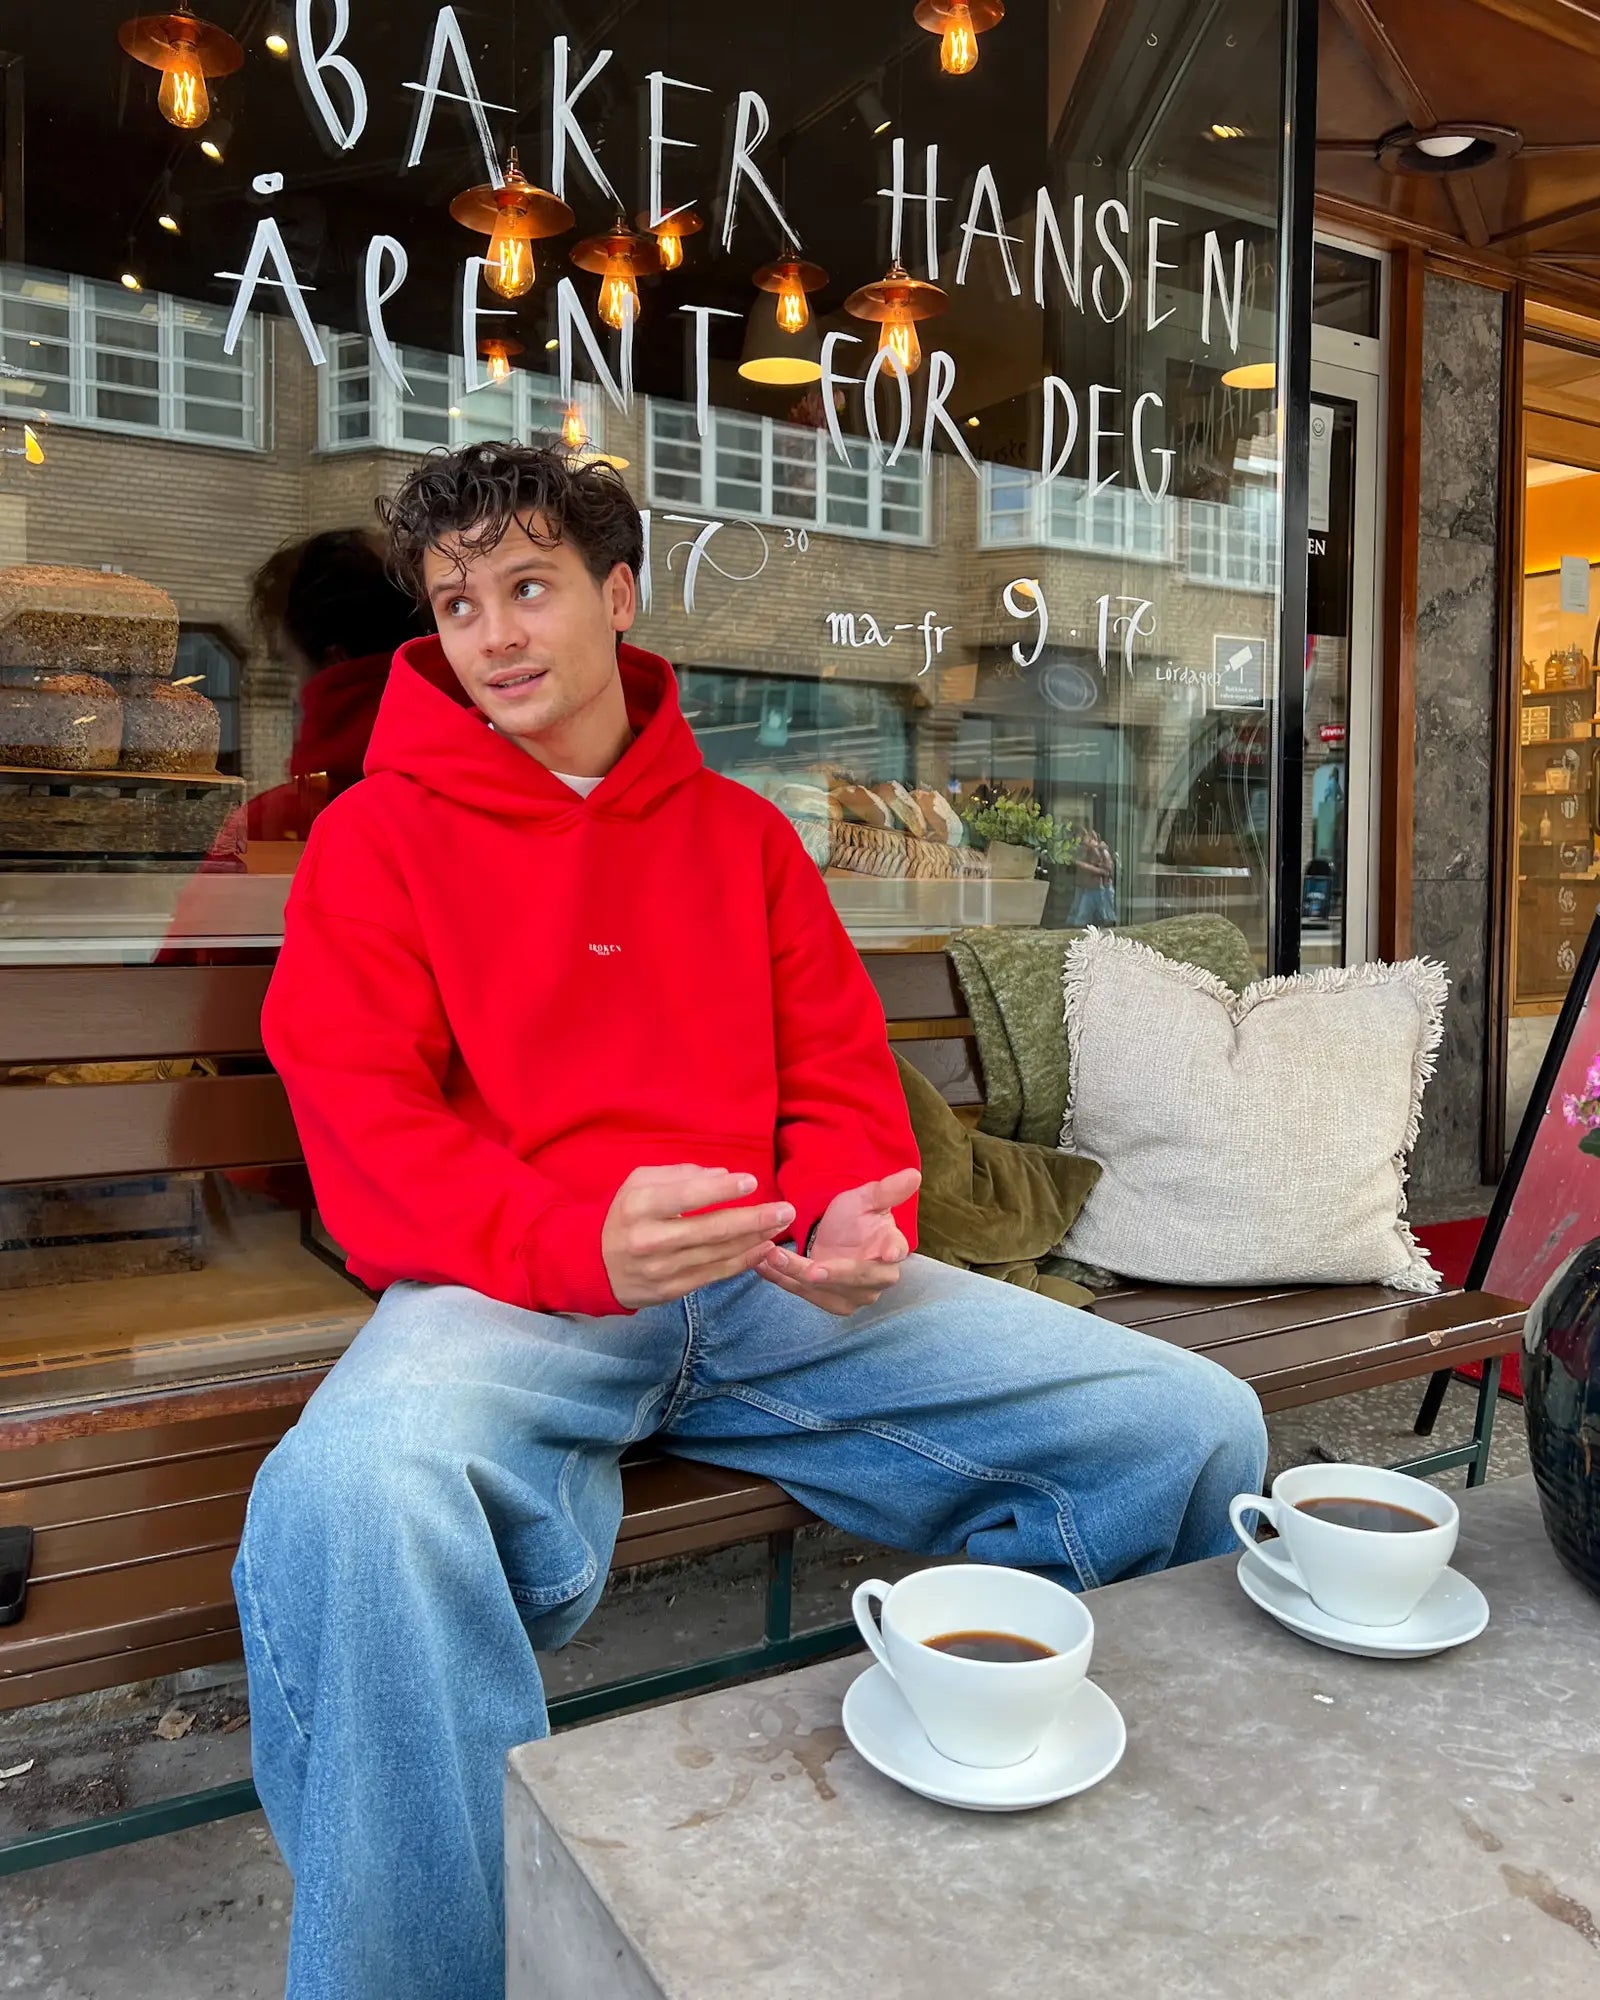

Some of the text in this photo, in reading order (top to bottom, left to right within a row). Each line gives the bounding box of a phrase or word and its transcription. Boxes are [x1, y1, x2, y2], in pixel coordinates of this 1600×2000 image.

[213, 171, 744, 437] ÅPENT
[820, 331, 982, 481] FOR
[1039, 375, 1178, 506] DEG
[295, 0, 1245, 356] BAKER HANSEN
[782, 527, 810, 553] 30
